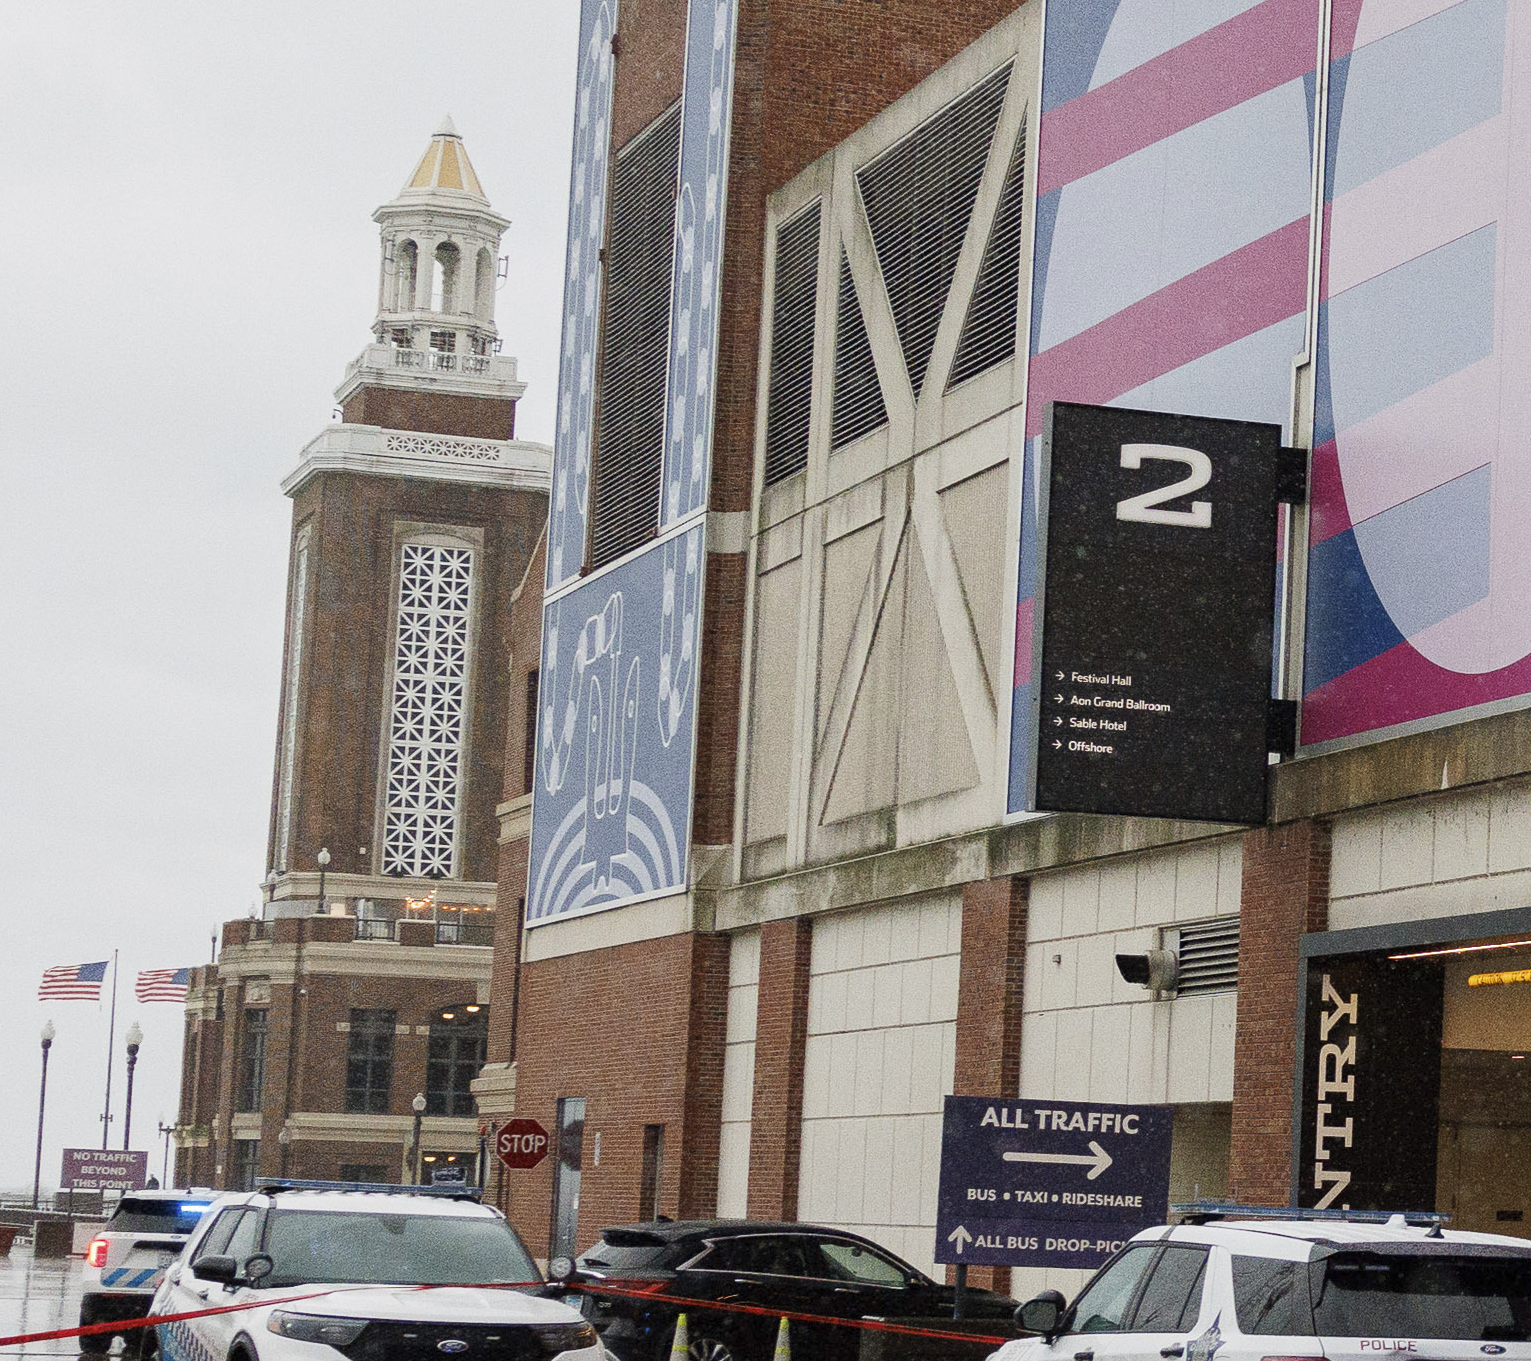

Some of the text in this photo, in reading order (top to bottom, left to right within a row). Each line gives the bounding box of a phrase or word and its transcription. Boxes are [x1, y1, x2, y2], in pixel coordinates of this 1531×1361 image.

[1116, 443, 1212, 528] 2
[1072, 672, 1132, 686] Festival Hall
[1070, 695, 1170, 712] Aon Grand Ballroom
[1070, 718, 1127, 731] Sable Hotel
[1068, 741, 1113, 753] Offshore
[1314, 974, 1358, 1210] NTRY
[980, 1107, 1140, 1134] ALL TRAFFIC
[500, 1134, 546, 1153] STOP
[73, 1152, 137, 1162] NO TRAFFIC
[81, 1166, 127, 1175] BEYOND
[73, 1179, 134, 1189] THIS POINT
[967, 1189, 1142, 1207] BUS TAXI RIDESHARE
[975, 1235, 1126, 1253] ALL BUS DROP-PIC
[1360, 1340, 1418, 1352] POLICE
